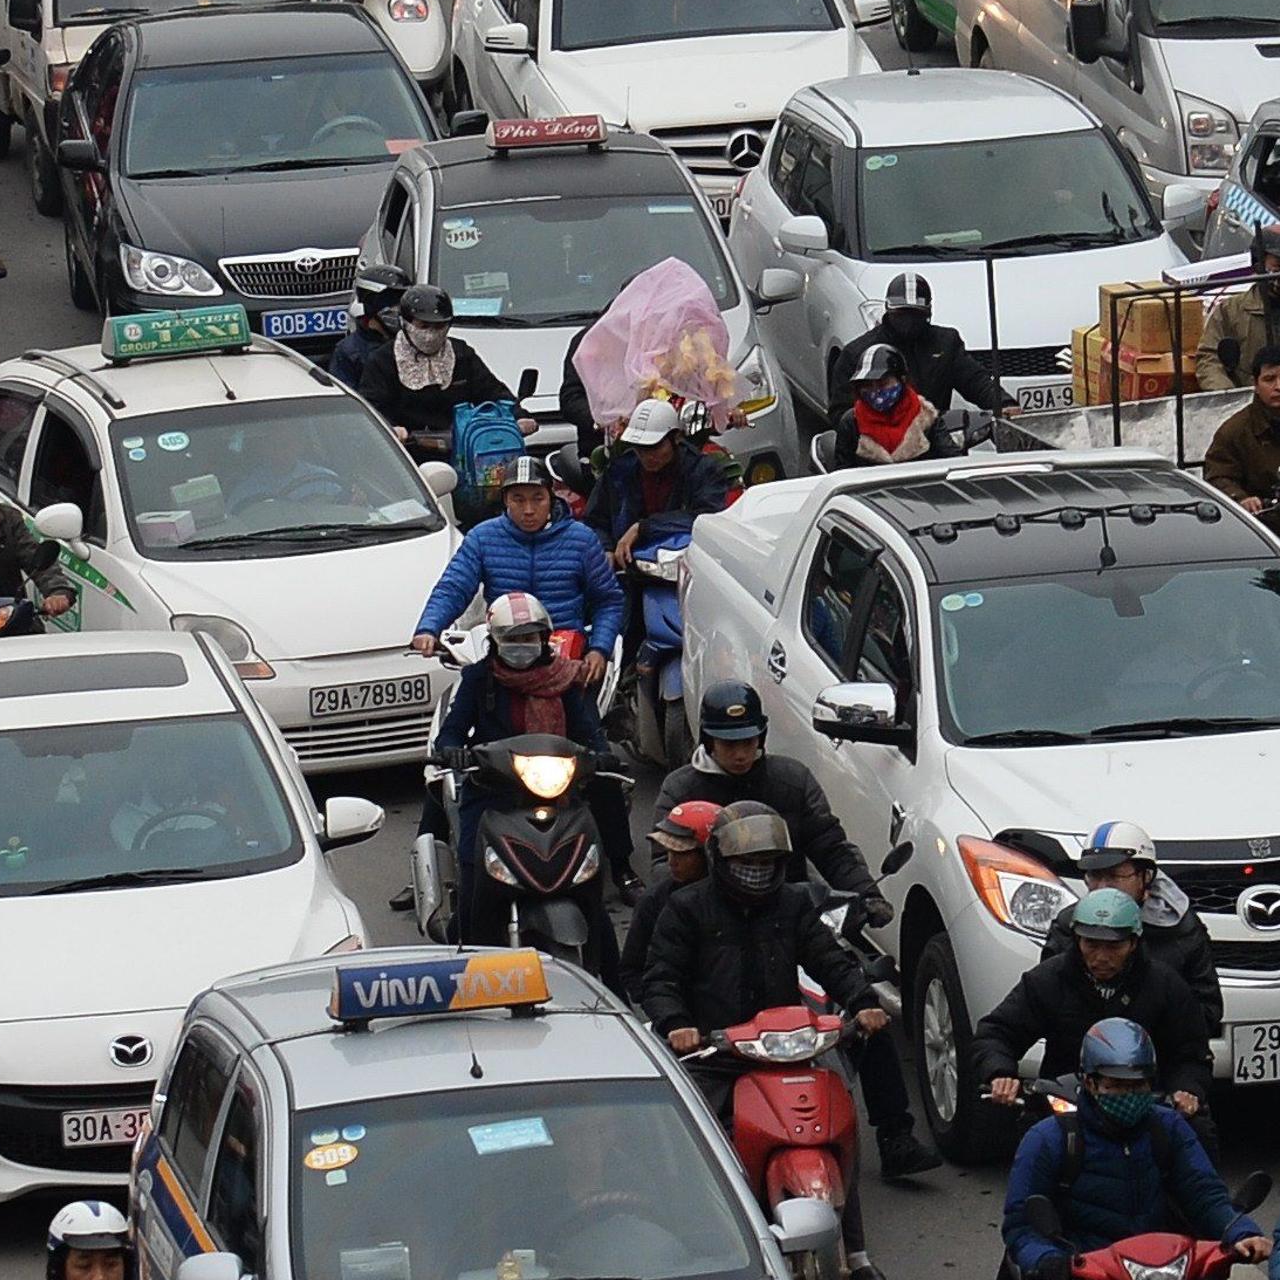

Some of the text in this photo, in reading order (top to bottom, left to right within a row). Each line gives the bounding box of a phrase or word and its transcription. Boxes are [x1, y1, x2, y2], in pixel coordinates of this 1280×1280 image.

[494, 119, 601, 144] Phù Đổng
[158, 322, 243, 345] TAXI
[315, 678, 428, 715] 29A-789.98
[352, 964, 534, 1009] VINA TAXI
